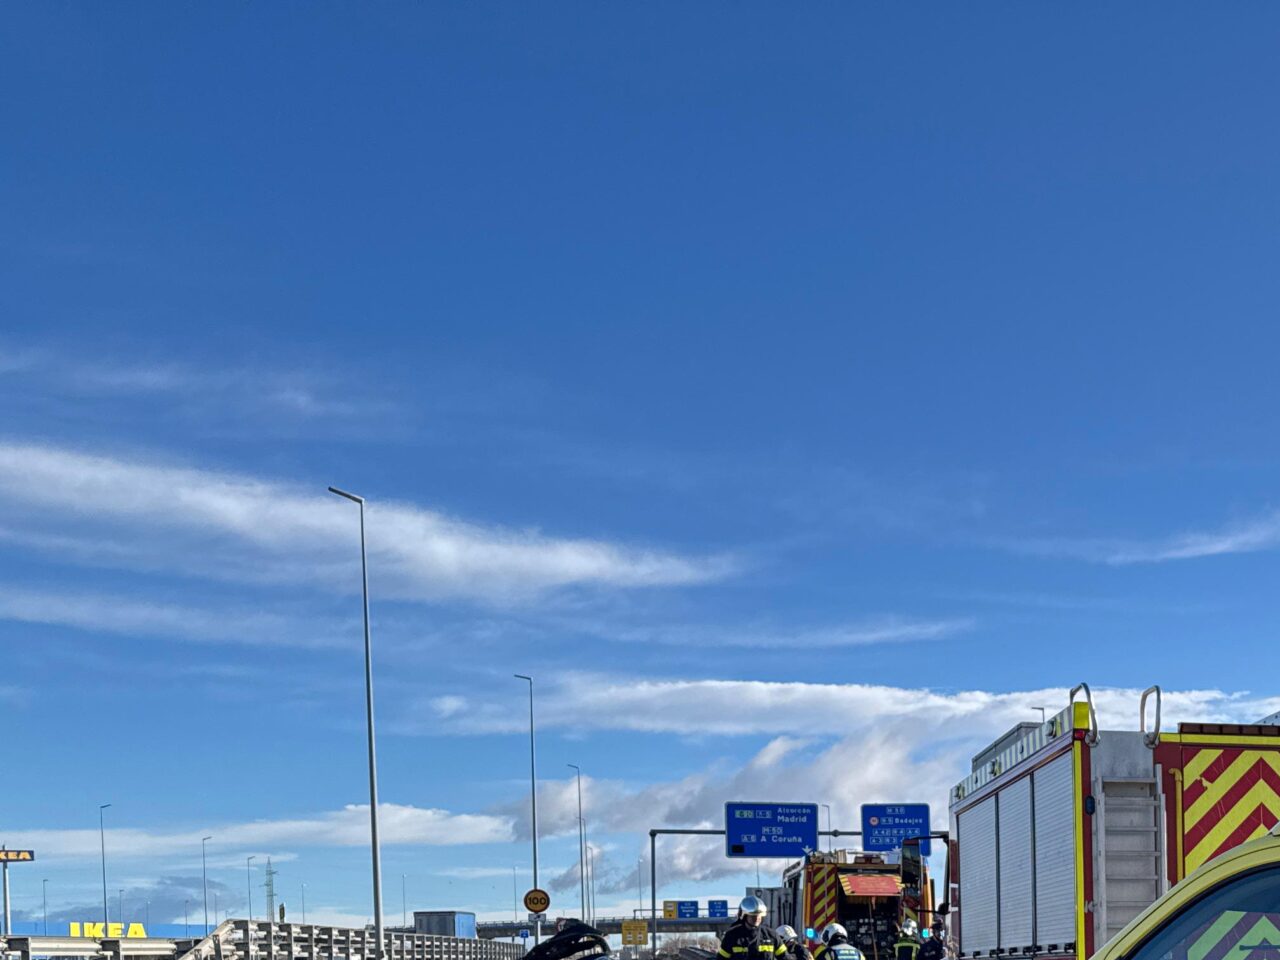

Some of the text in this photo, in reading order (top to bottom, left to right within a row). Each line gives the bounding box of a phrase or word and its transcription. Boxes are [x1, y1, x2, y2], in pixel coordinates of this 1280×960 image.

[777, 815, 808, 823] Madrid
[771, 835, 803, 843] Coruña
[0, 851, 31, 860] KEA
[528, 897, 547, 905] 100
[69, 922, 147, 938] IKEA
